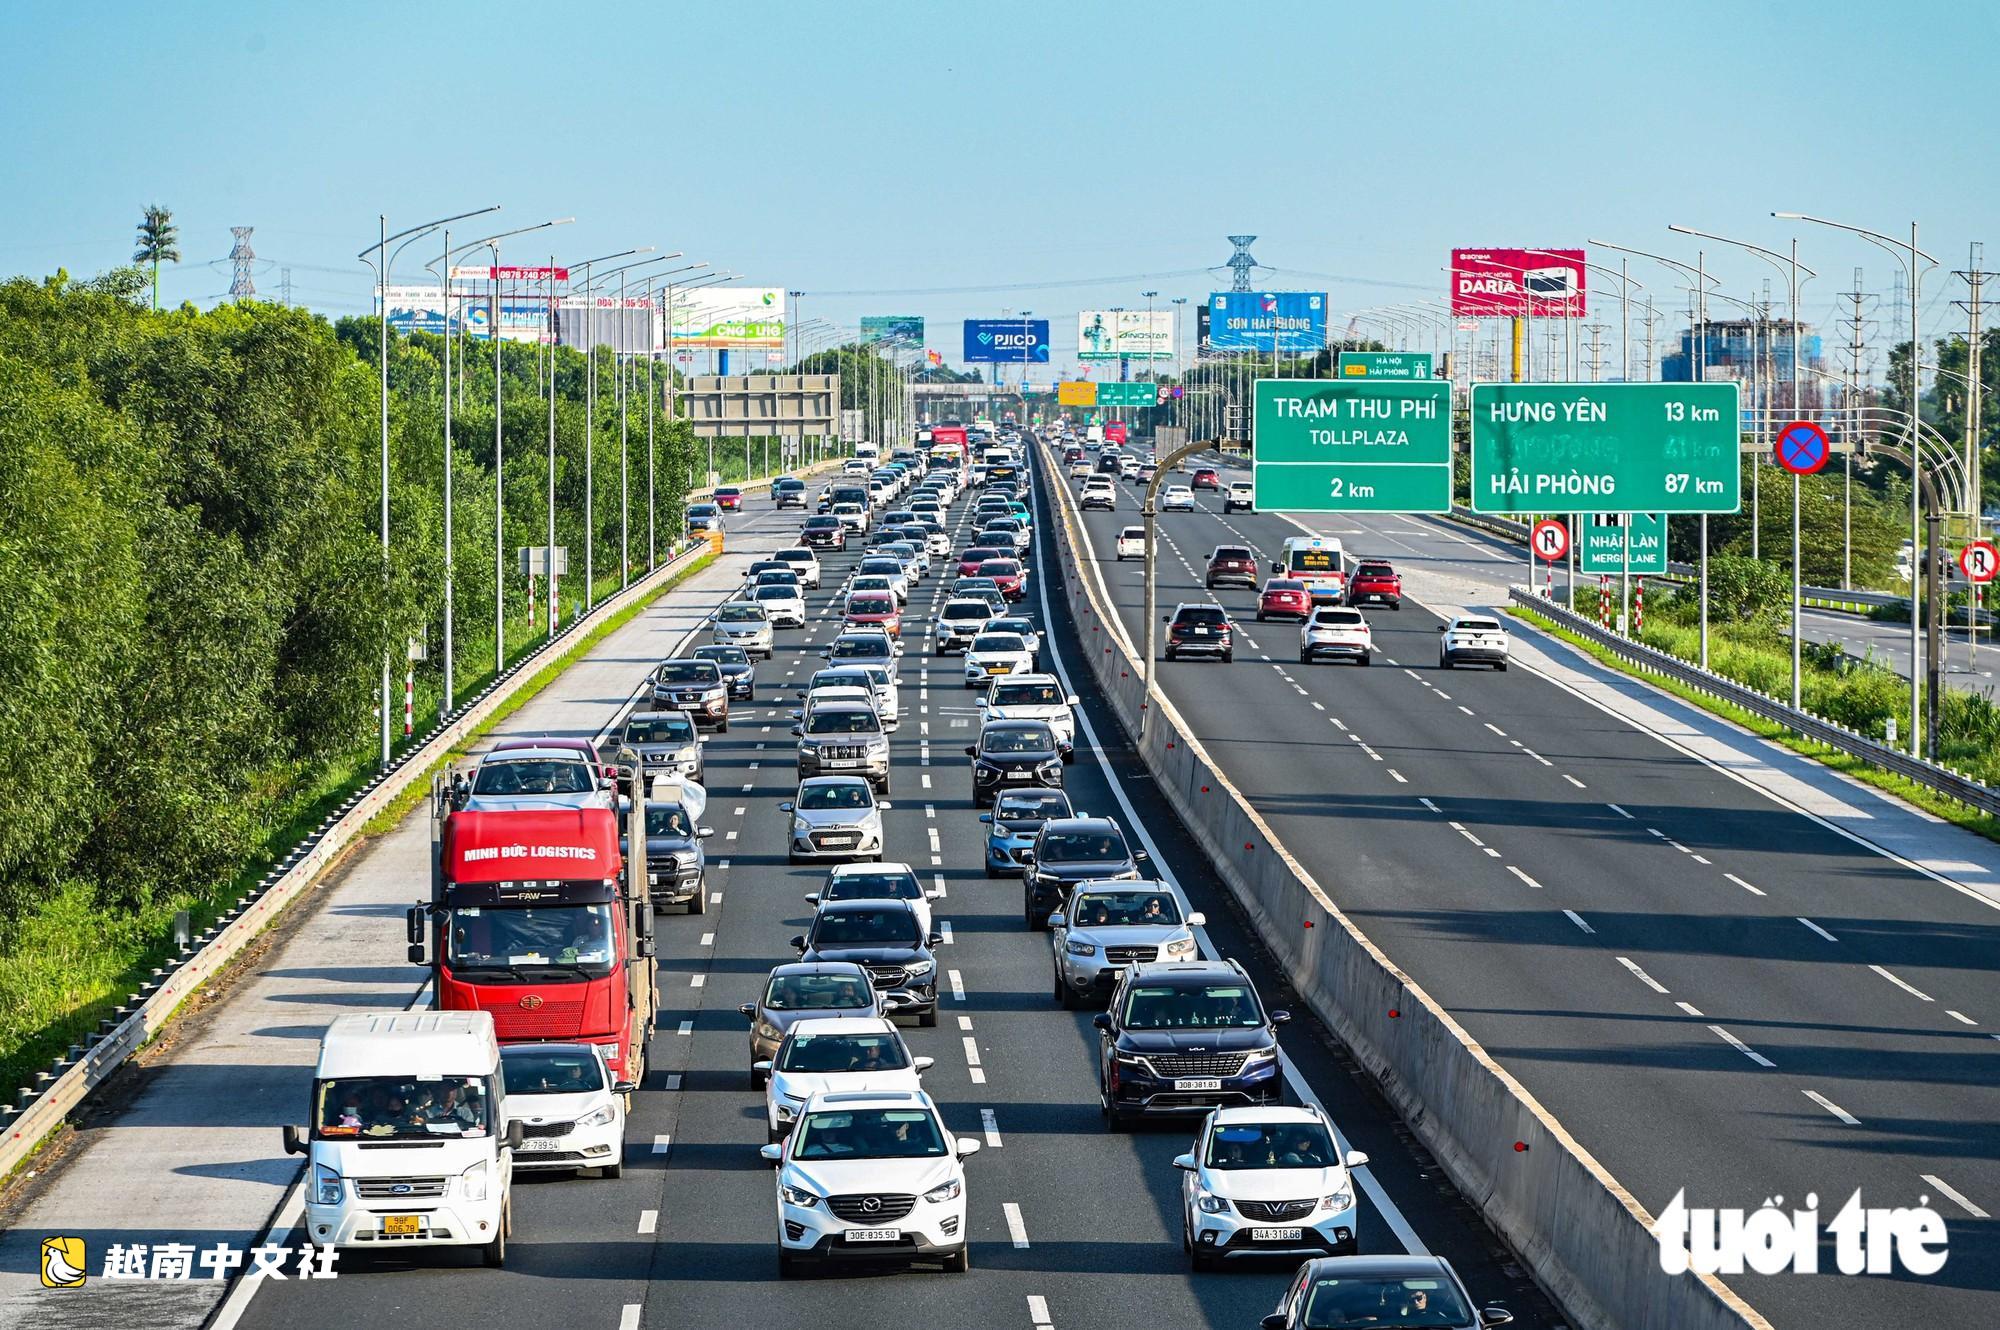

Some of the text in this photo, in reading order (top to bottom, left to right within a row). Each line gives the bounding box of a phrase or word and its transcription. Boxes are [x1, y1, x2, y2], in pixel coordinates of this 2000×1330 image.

[1459, 279, 1516, 294] DARIA
[994, 334, 1037, 346] PJICO
[1273, 393, 1439, 423] TRẠM THU PHÍ
[1490, 397, 1720, 423] HƯNG YÊN 13 km
[1309, 430, 1410, 446] TOLLPLAZA
[1330, 477, 1375, 498] 2 km
[1490, 467, 1724, 495] HẢI PHÒNG 87 km
[1630, 532, 1659, 549] LÀN
[1629, 554, 1657, 564] LANE
[464, 842, 597, 862] MINH ĐỨC LOGISTICS
[518, 892, 541, 901] FAW
[1253, 1229, 1301, 1239] 34A-318.66
